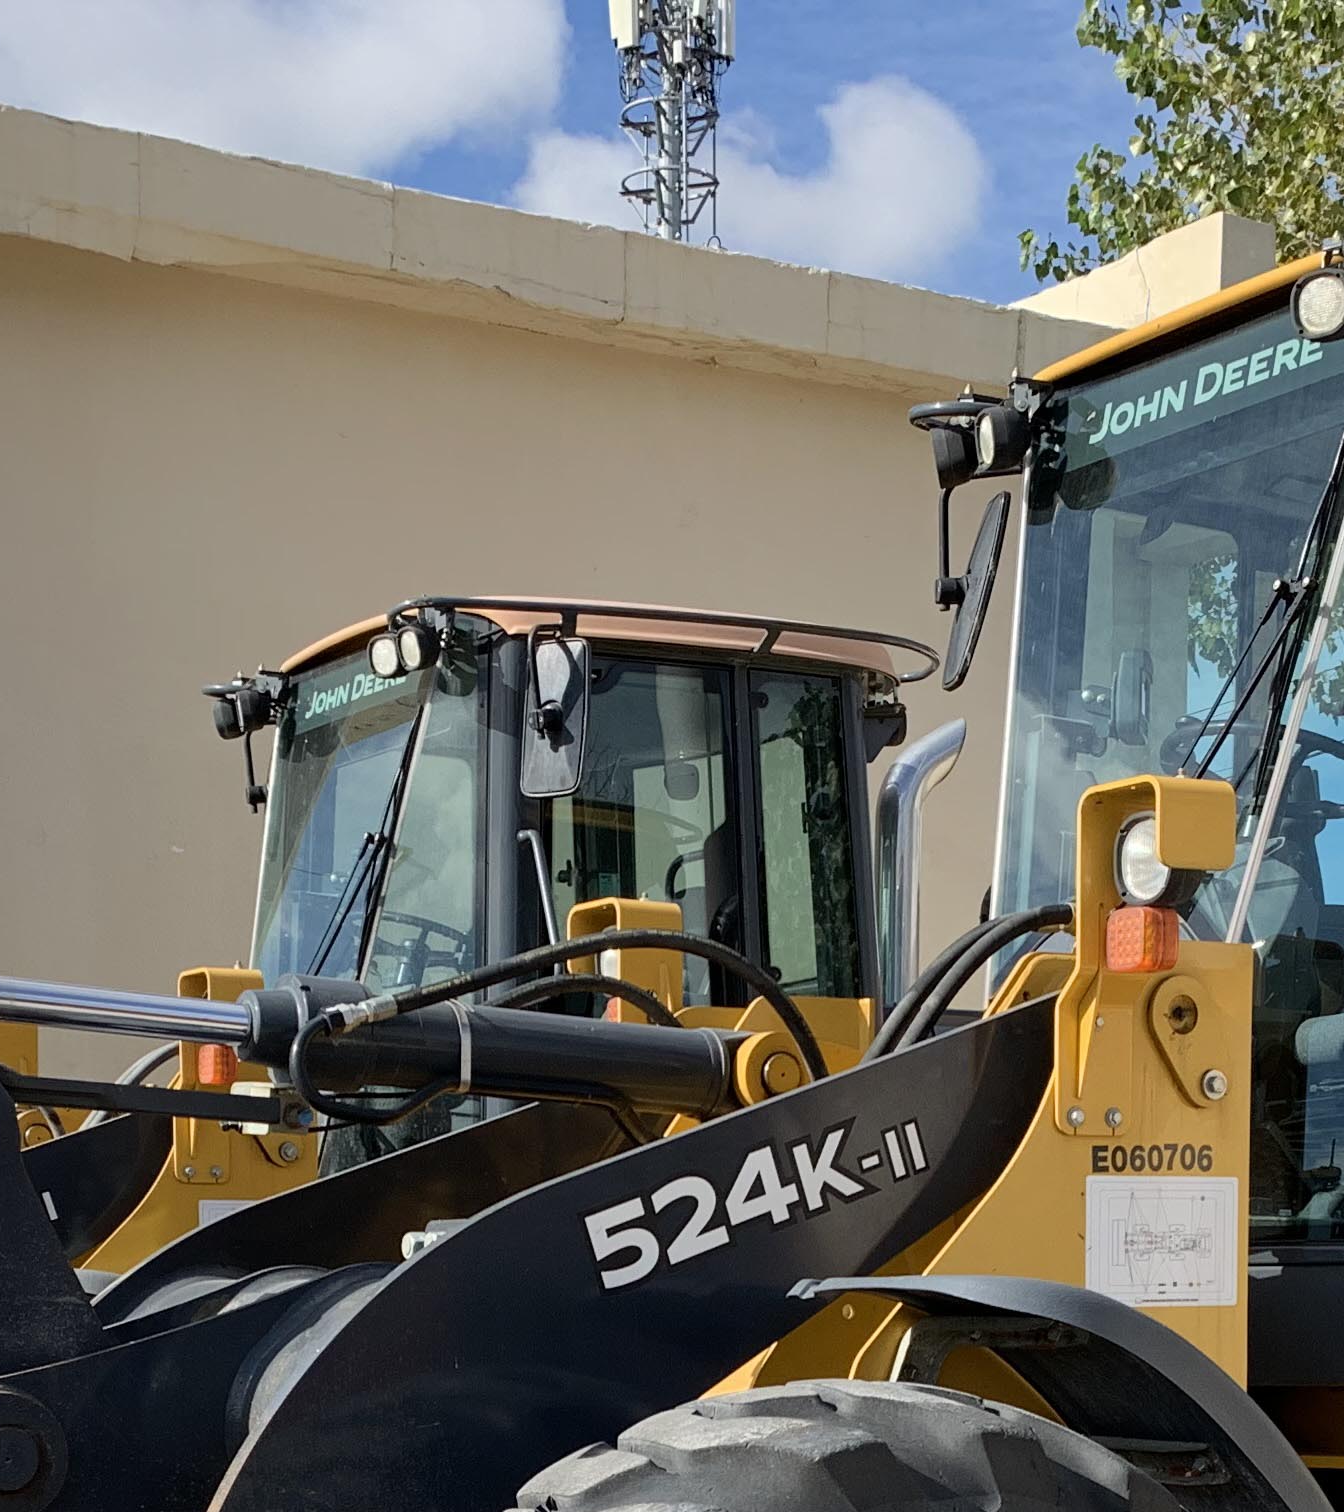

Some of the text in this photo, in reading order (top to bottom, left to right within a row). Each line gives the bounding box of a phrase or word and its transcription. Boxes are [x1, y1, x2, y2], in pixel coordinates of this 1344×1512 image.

[1089, 338, 1324, 445] JOHN DEERE
[304, 682, 350, 720] JOHN
[1091, 1143, 1213, 1173] E060706
